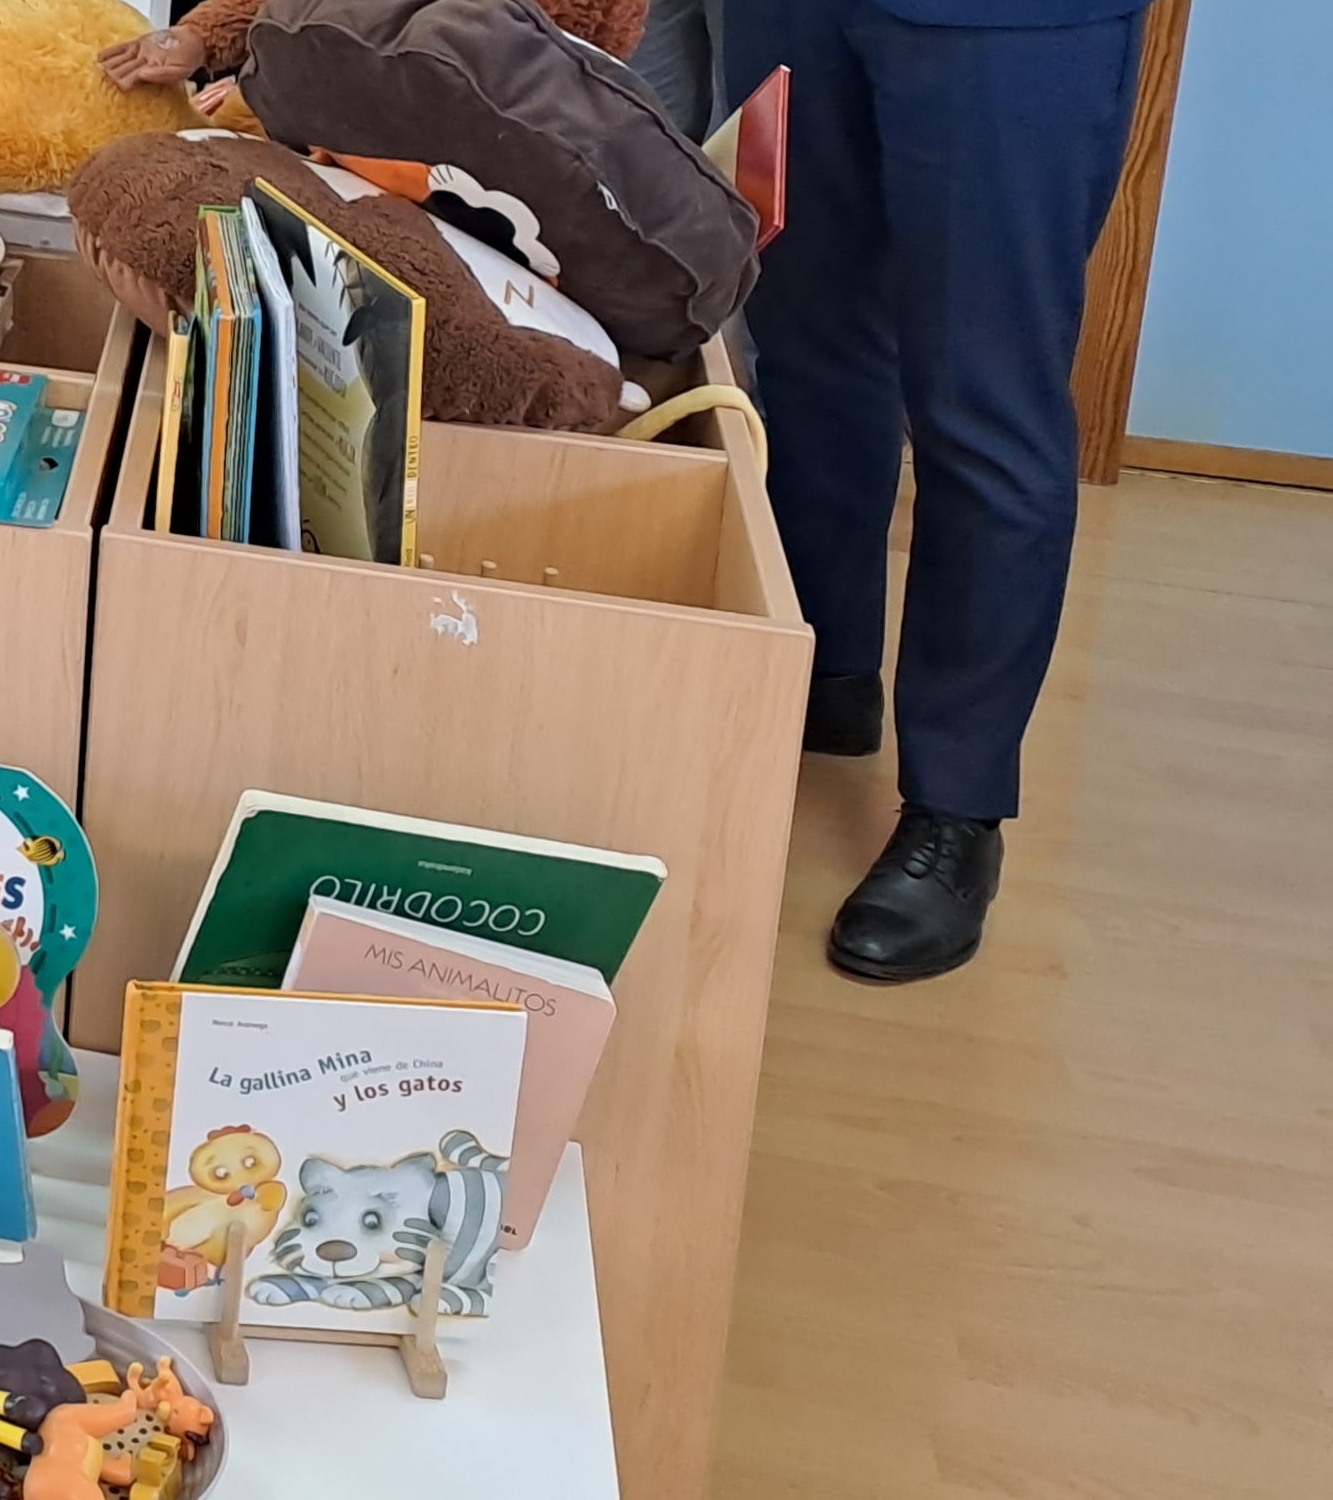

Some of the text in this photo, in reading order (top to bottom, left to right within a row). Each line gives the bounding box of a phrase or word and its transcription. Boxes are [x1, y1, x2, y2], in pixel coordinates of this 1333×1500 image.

[308, 874, 546, 936] COCODRILO
[364, 943, 558, 1017] MIS ANIMALITOS
[208, 1047, 373, 1095] La gallina Mina
[332, 1075, 464, 1113] y los gatos
[339, 1058, 444, 1084] que viene de China
